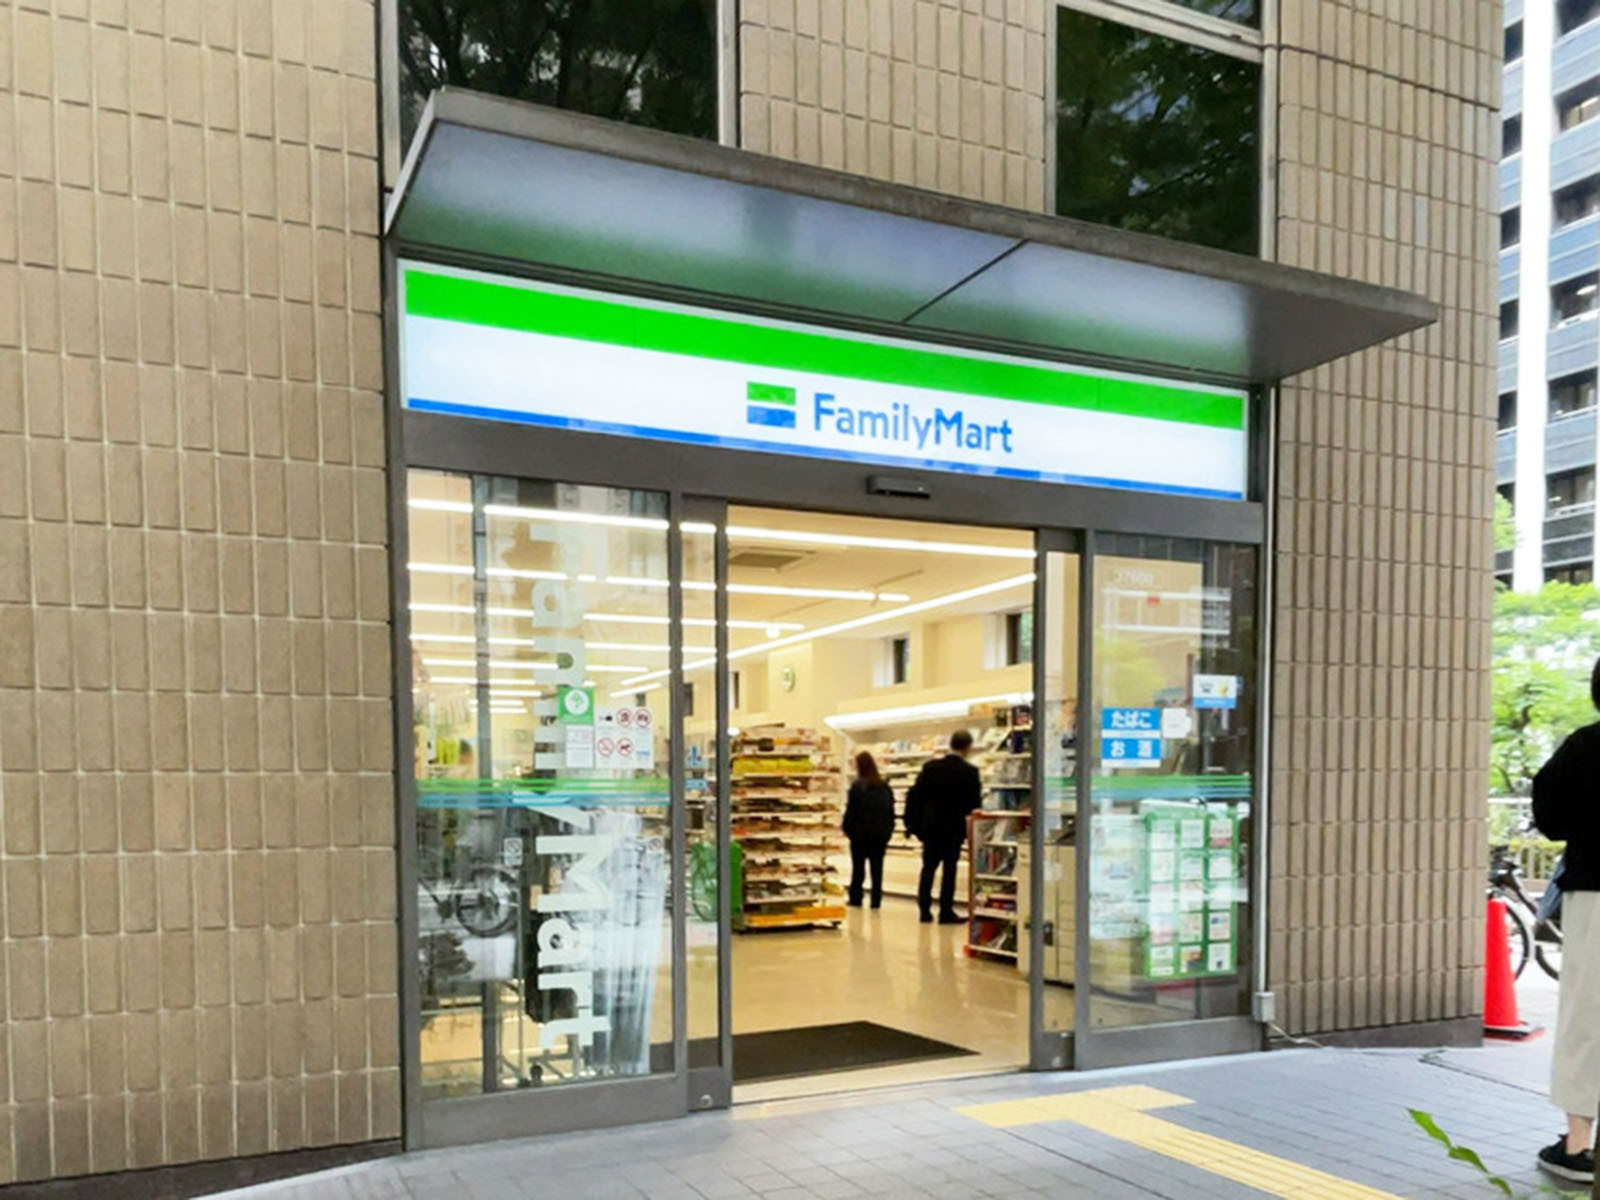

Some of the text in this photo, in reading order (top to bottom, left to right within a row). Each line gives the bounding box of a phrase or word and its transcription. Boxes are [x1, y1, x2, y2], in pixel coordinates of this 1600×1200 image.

[814, 393, 1013, 453] FamilyMart
[1110, 711, 1152, 729] たばこ
